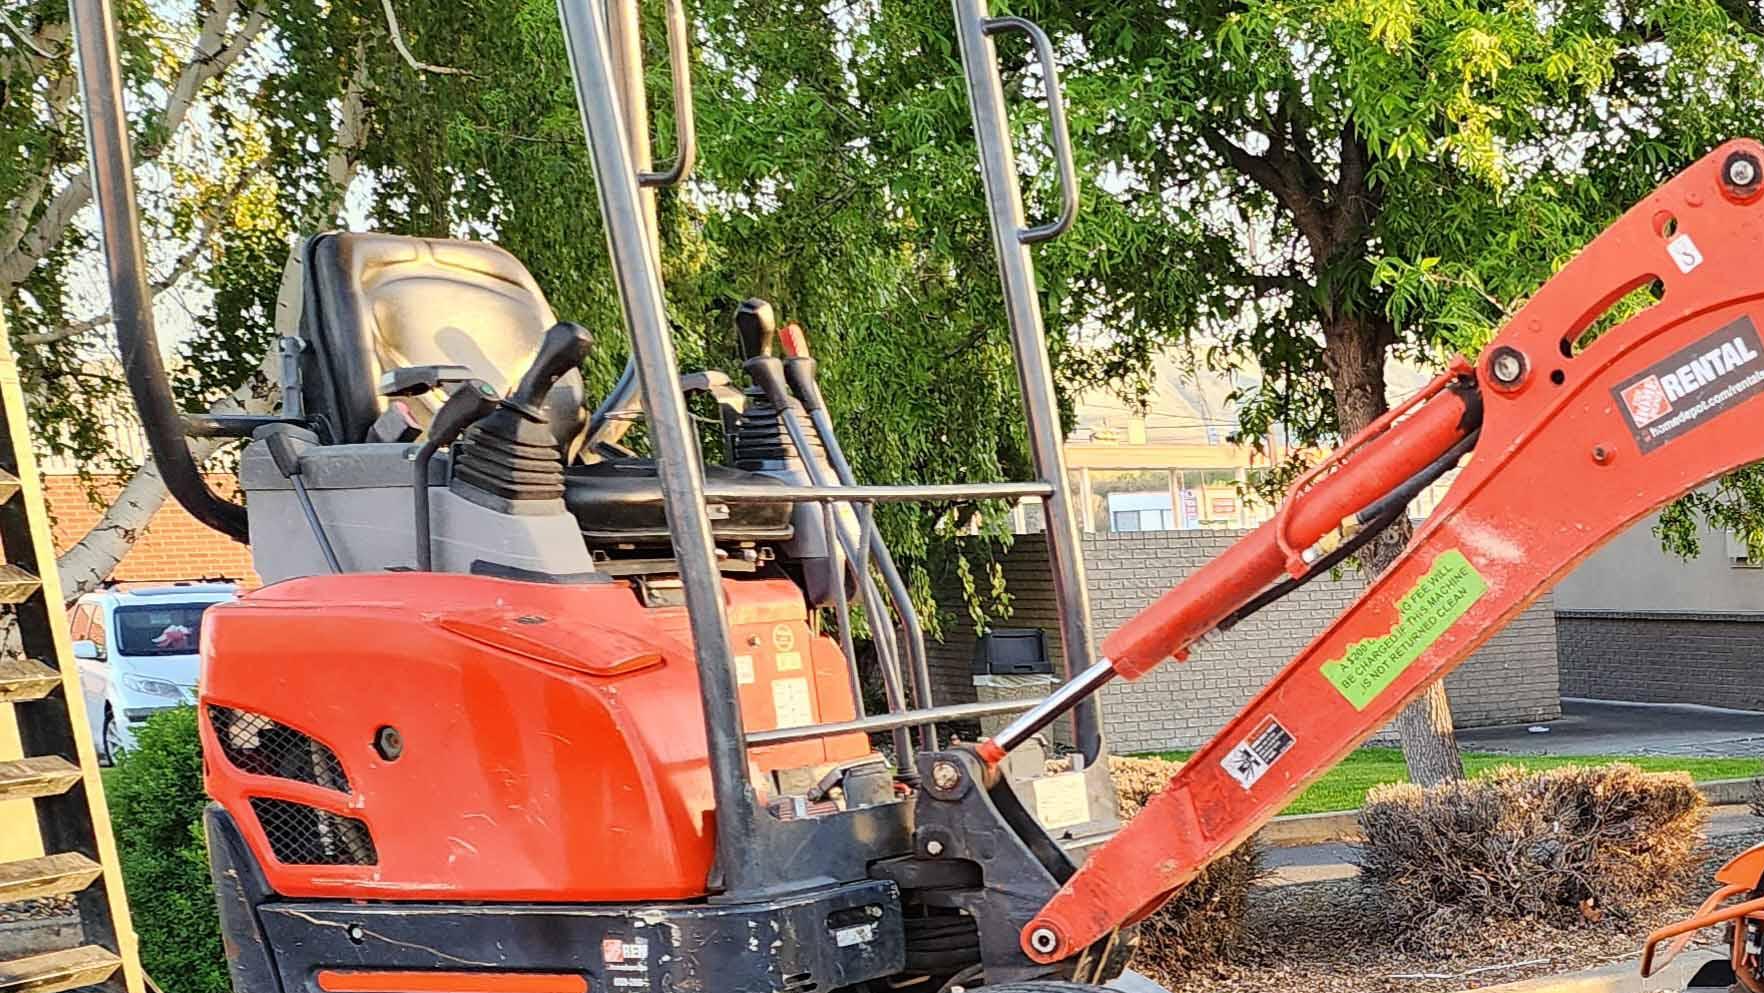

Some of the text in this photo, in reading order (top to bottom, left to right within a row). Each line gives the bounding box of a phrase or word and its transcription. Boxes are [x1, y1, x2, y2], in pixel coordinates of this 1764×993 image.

[1660, 336, 1758, 402] RENTAL
[1341, 673, 1357, 690] BE
[1355, 633, 1399, 677] CHARGED
[1406, 606, 1430, 628] THIS
[1427, 566, 1470, 609] MACHINE
[1410, 584, 1431, 608] FEE
[1428, 564, 1453, 588] WILL
[1360, 677, 1373, 691] IS
[1370, 660, 1392, 681] NOT
[1389, 614, 1438, 663] RETURNED
[1436, 586, 1469, 620] CLEAN
